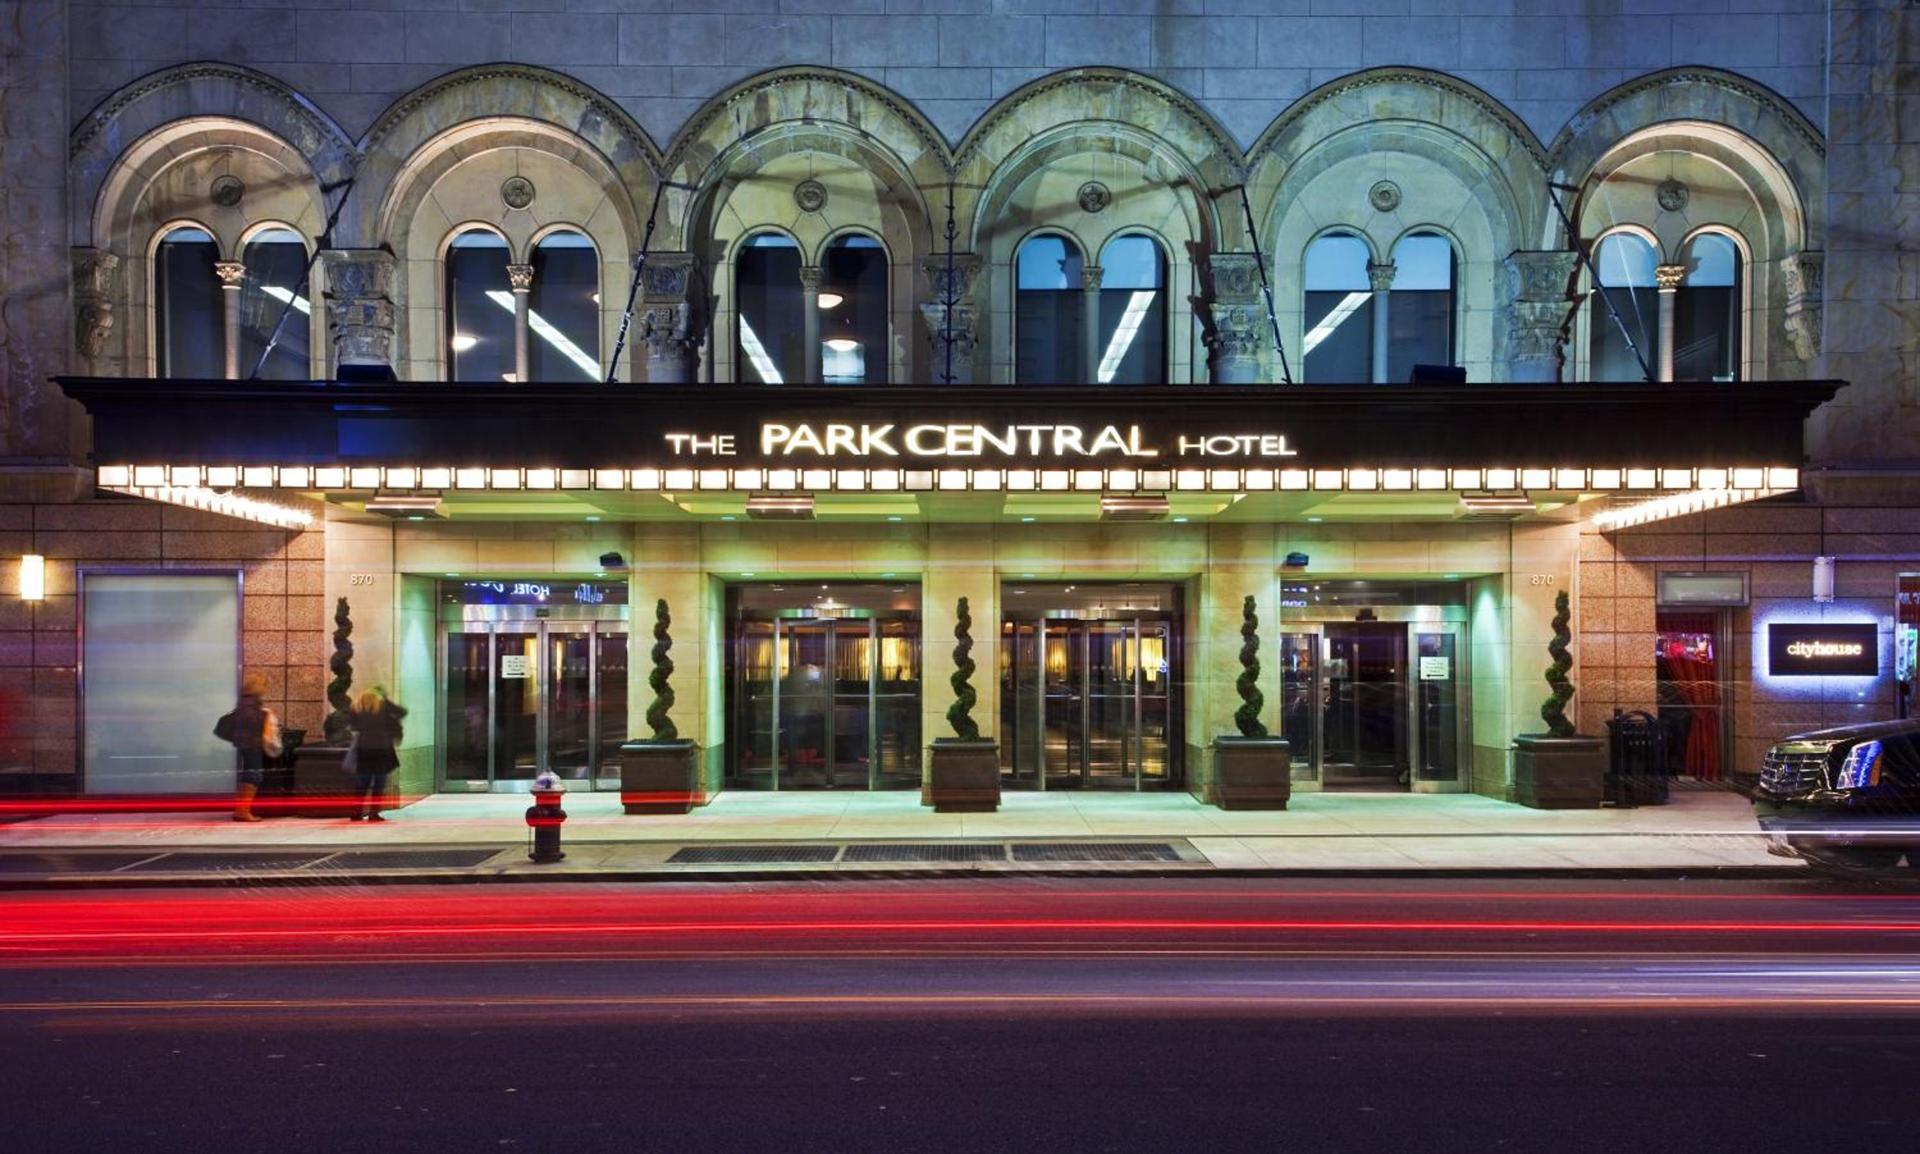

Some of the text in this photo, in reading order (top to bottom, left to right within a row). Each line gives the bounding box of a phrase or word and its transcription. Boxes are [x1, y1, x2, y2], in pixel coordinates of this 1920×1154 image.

[665, 423, 1298, 457] THE PARK CENTRAL HOTEL
[350, 574, 374, 586] 870
[1532, 574, 1554, 585] 870
[1786, 641, 1863, 659] cityhouse
